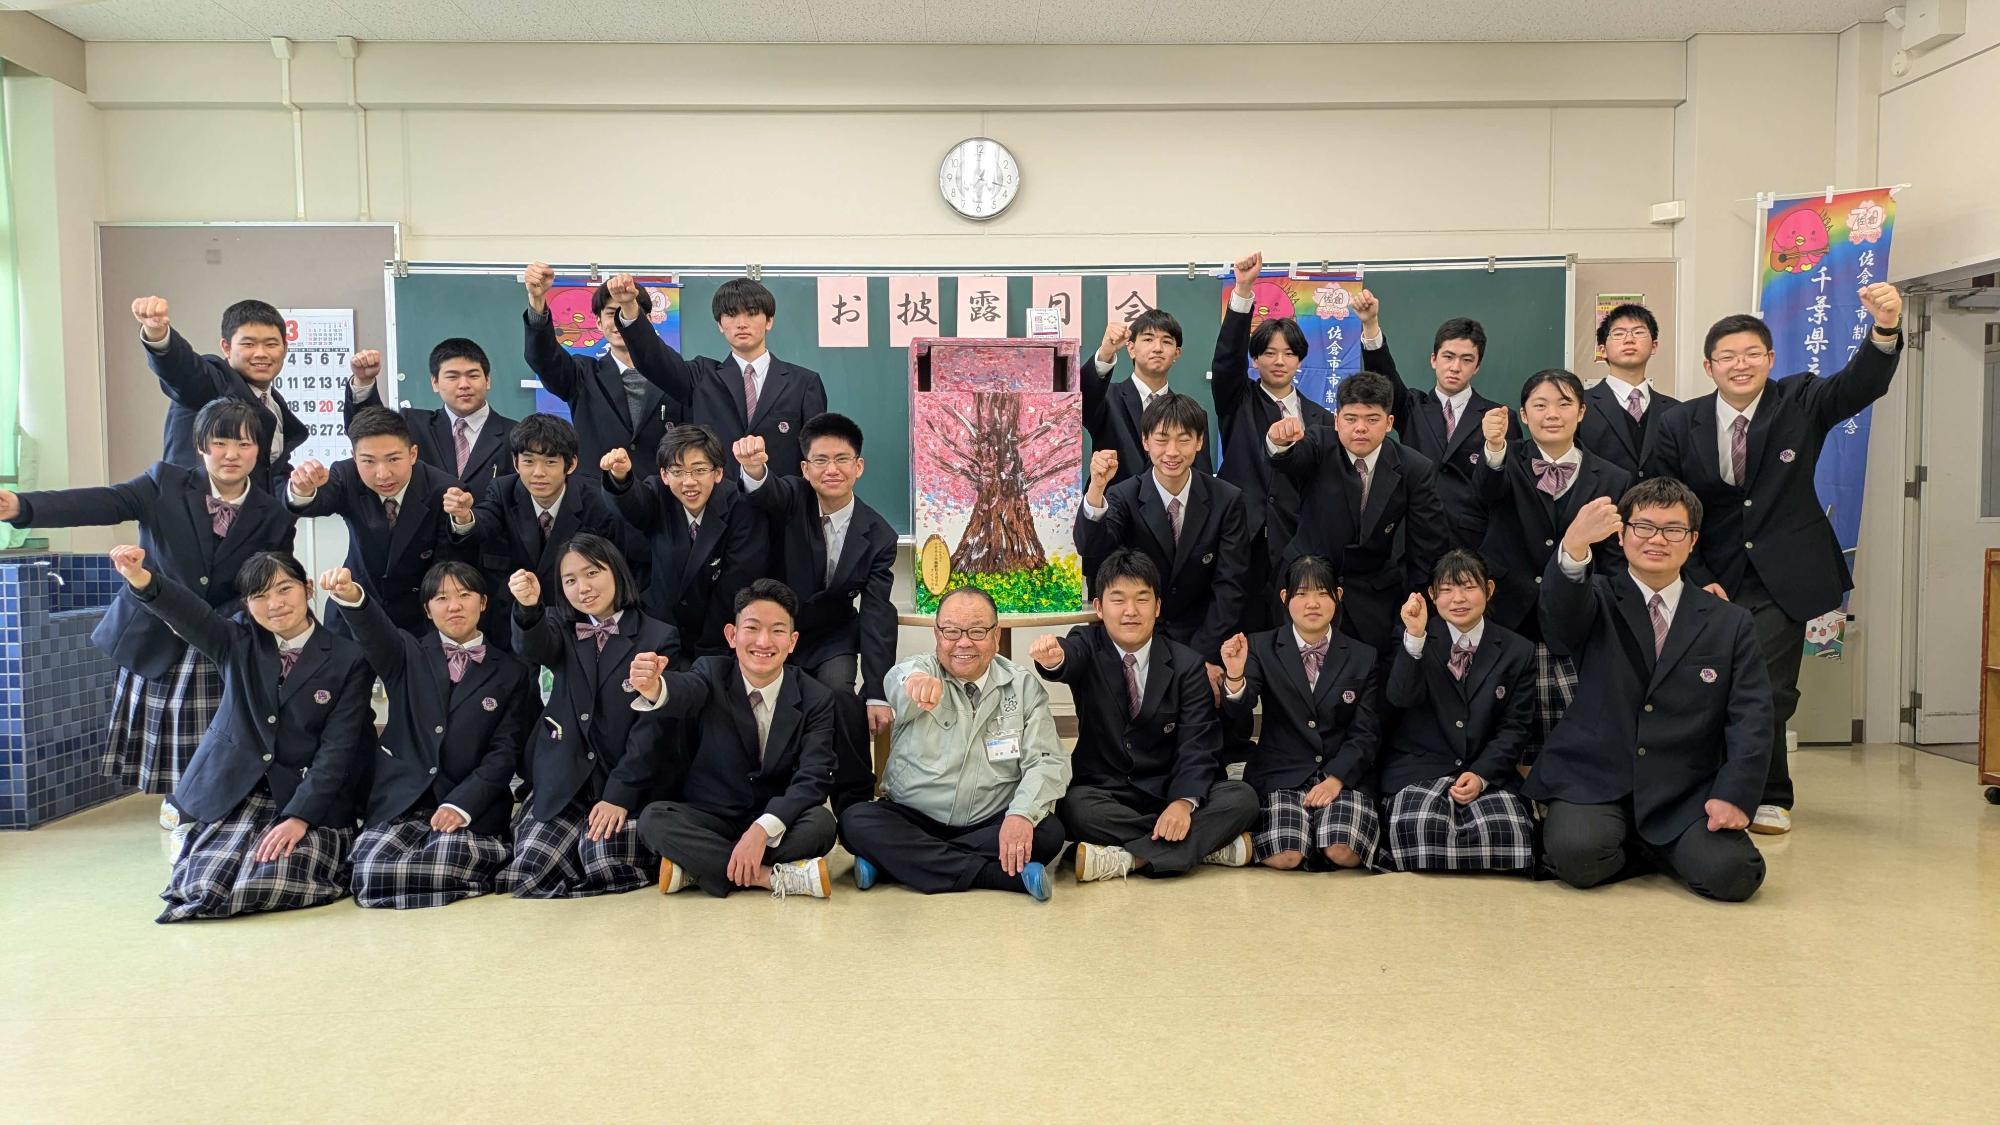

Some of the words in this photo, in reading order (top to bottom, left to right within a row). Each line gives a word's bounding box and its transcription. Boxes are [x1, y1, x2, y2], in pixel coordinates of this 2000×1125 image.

[976, 144, 984, 154] 12
[1003, 159, 1009, 170] 2
[946, 173, 953, 183] 9
[1006, 174, 1012, 185] 3
[950, 188, 956, 198] 8
[975, 202, 982, 213] 6
[991, 200, 997, 210] 5
[286, 319, 299, 341] 3
[288, 353, 297, 365] 4
[304, 353, 313, 365] 5
[320, 353, 330, 365] 6
[336, 353, 346, 365] 7
[287, 376, 299, 389] 11
[302, 376, 316, 389] 12
[319, 376, 332, 389] 13
[287, 400, 300, 412] 18
[303, 400, 316, 412] 19
[319, 400, 334, 412] 20
[319, 423, 334, 436] 27
[308, 448, 314, 457] 2
[324, 448, 331, 457] 3
[341, 448, 347, 457] 4
